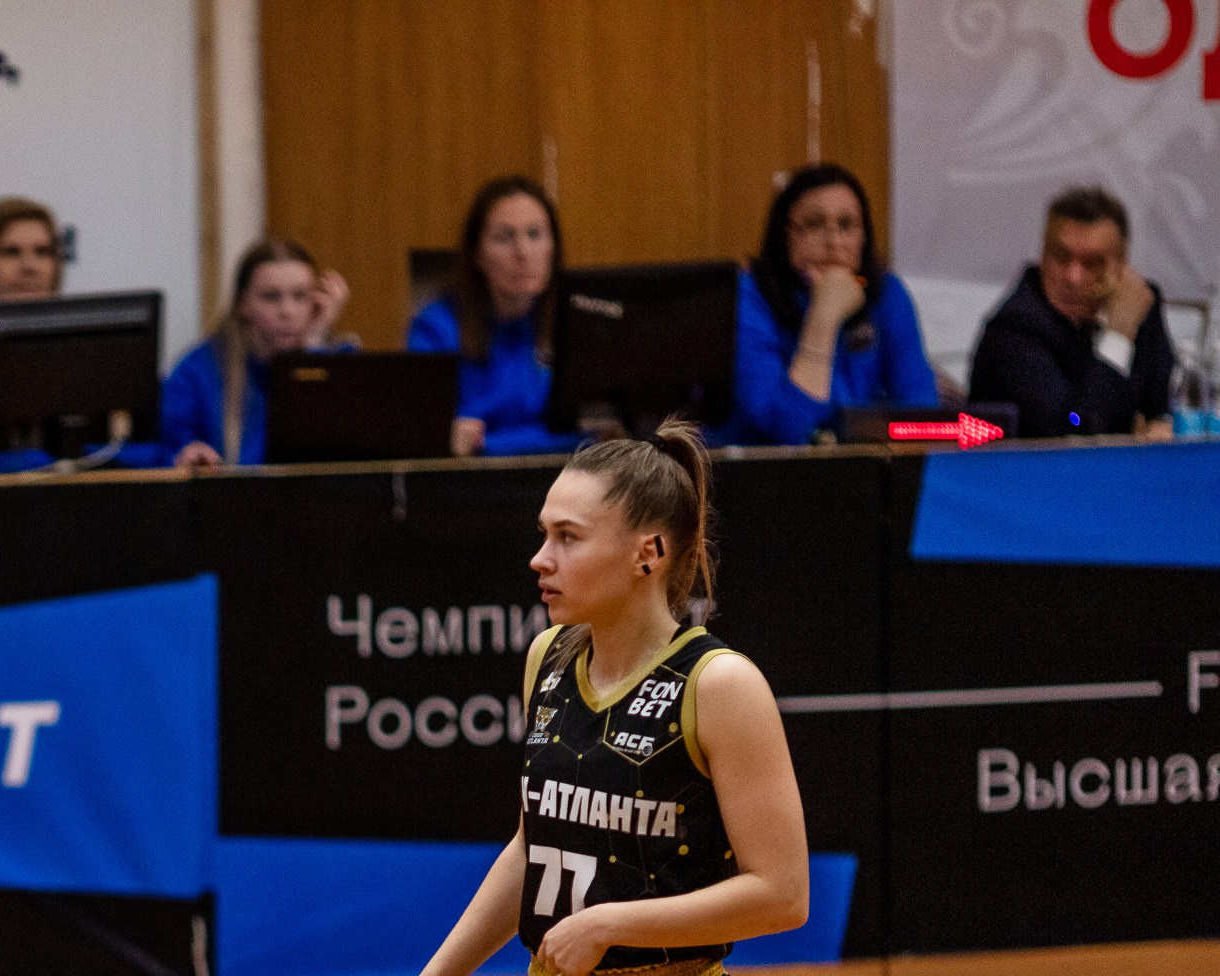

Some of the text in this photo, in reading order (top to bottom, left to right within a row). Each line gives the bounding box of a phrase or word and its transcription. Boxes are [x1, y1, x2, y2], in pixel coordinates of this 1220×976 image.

[638, 679, 684, 700] FON
[627, 697, 673, 718] BET
[529, 844, 598, 917] 77
